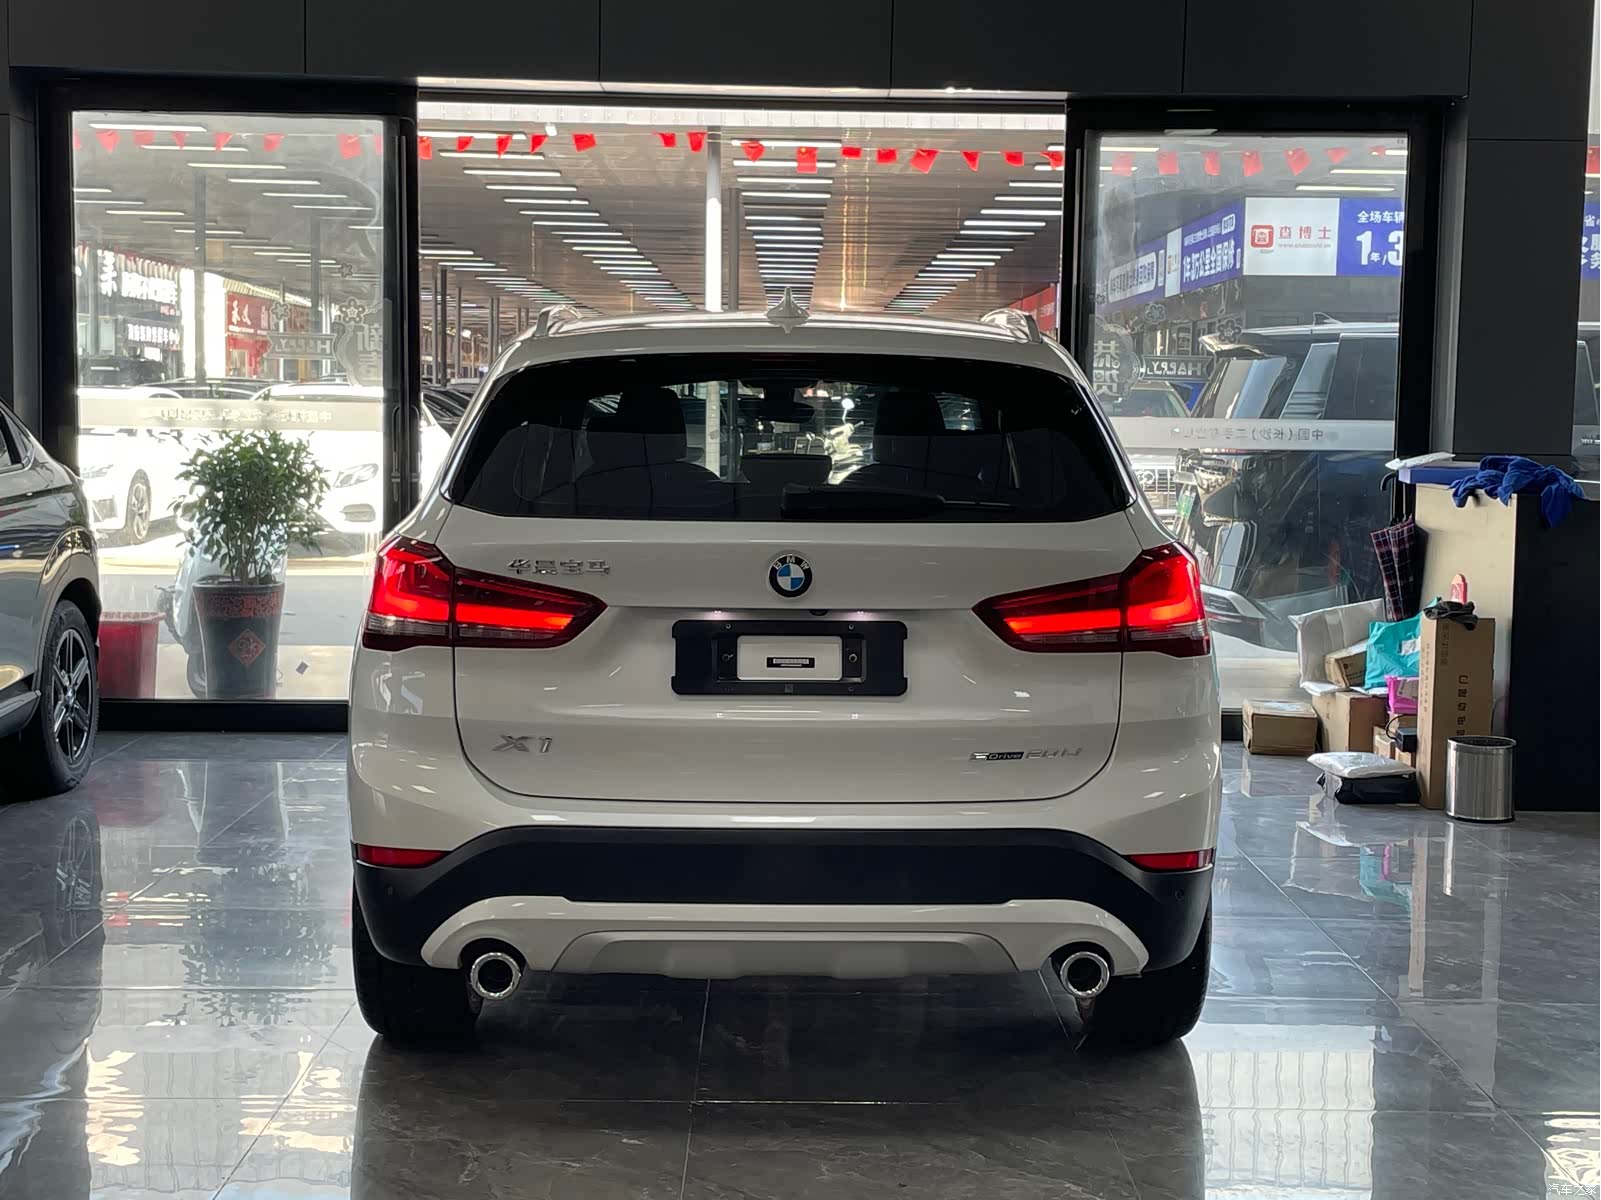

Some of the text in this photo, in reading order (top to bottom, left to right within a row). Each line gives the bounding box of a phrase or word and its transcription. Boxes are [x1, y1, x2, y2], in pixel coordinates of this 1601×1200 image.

[507, 559, 610, 576] 华晨宝马
[773, 554, 810, 570] BMW
[492, 735, 553, 753] X1
